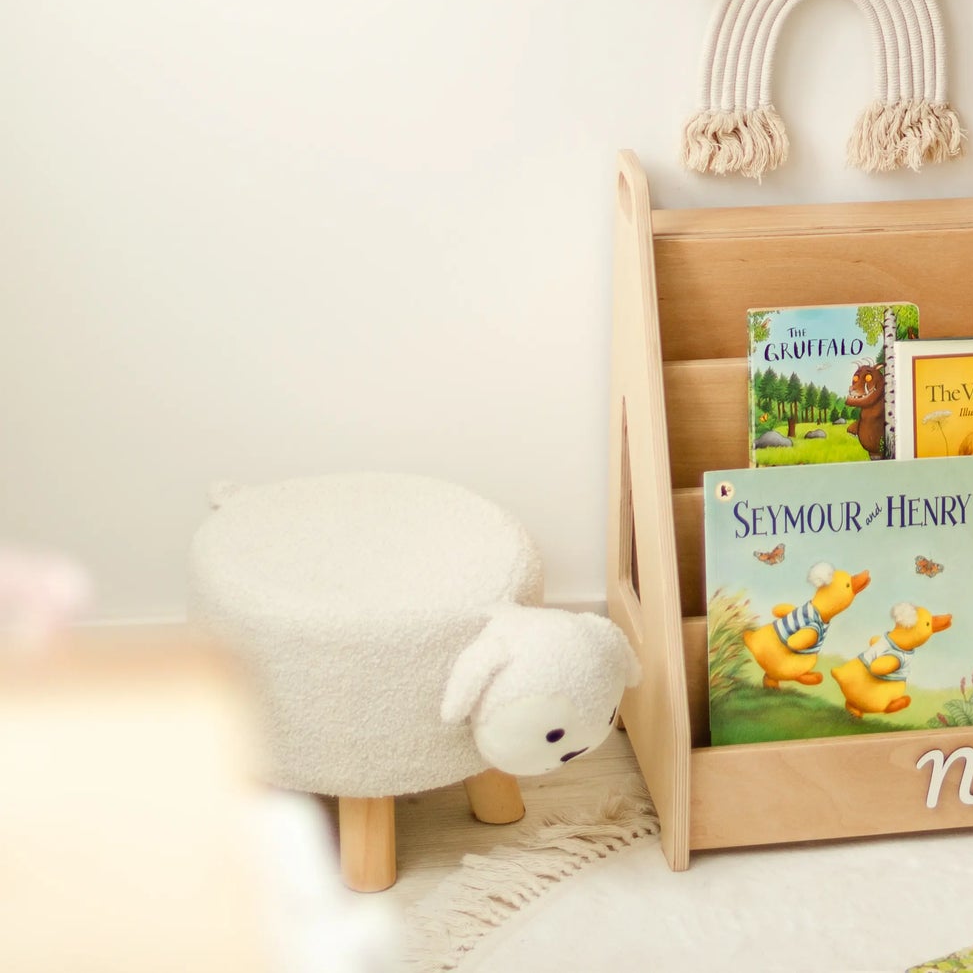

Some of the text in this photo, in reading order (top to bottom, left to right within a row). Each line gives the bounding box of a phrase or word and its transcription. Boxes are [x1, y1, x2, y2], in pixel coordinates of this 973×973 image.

[787, 327, 807, 338] THE
[764, 338, 864, 362] GRUFFALO
[925, 384, 961, 403] The
[733, 493, 973, 538] SEYMOUR and HENRY
